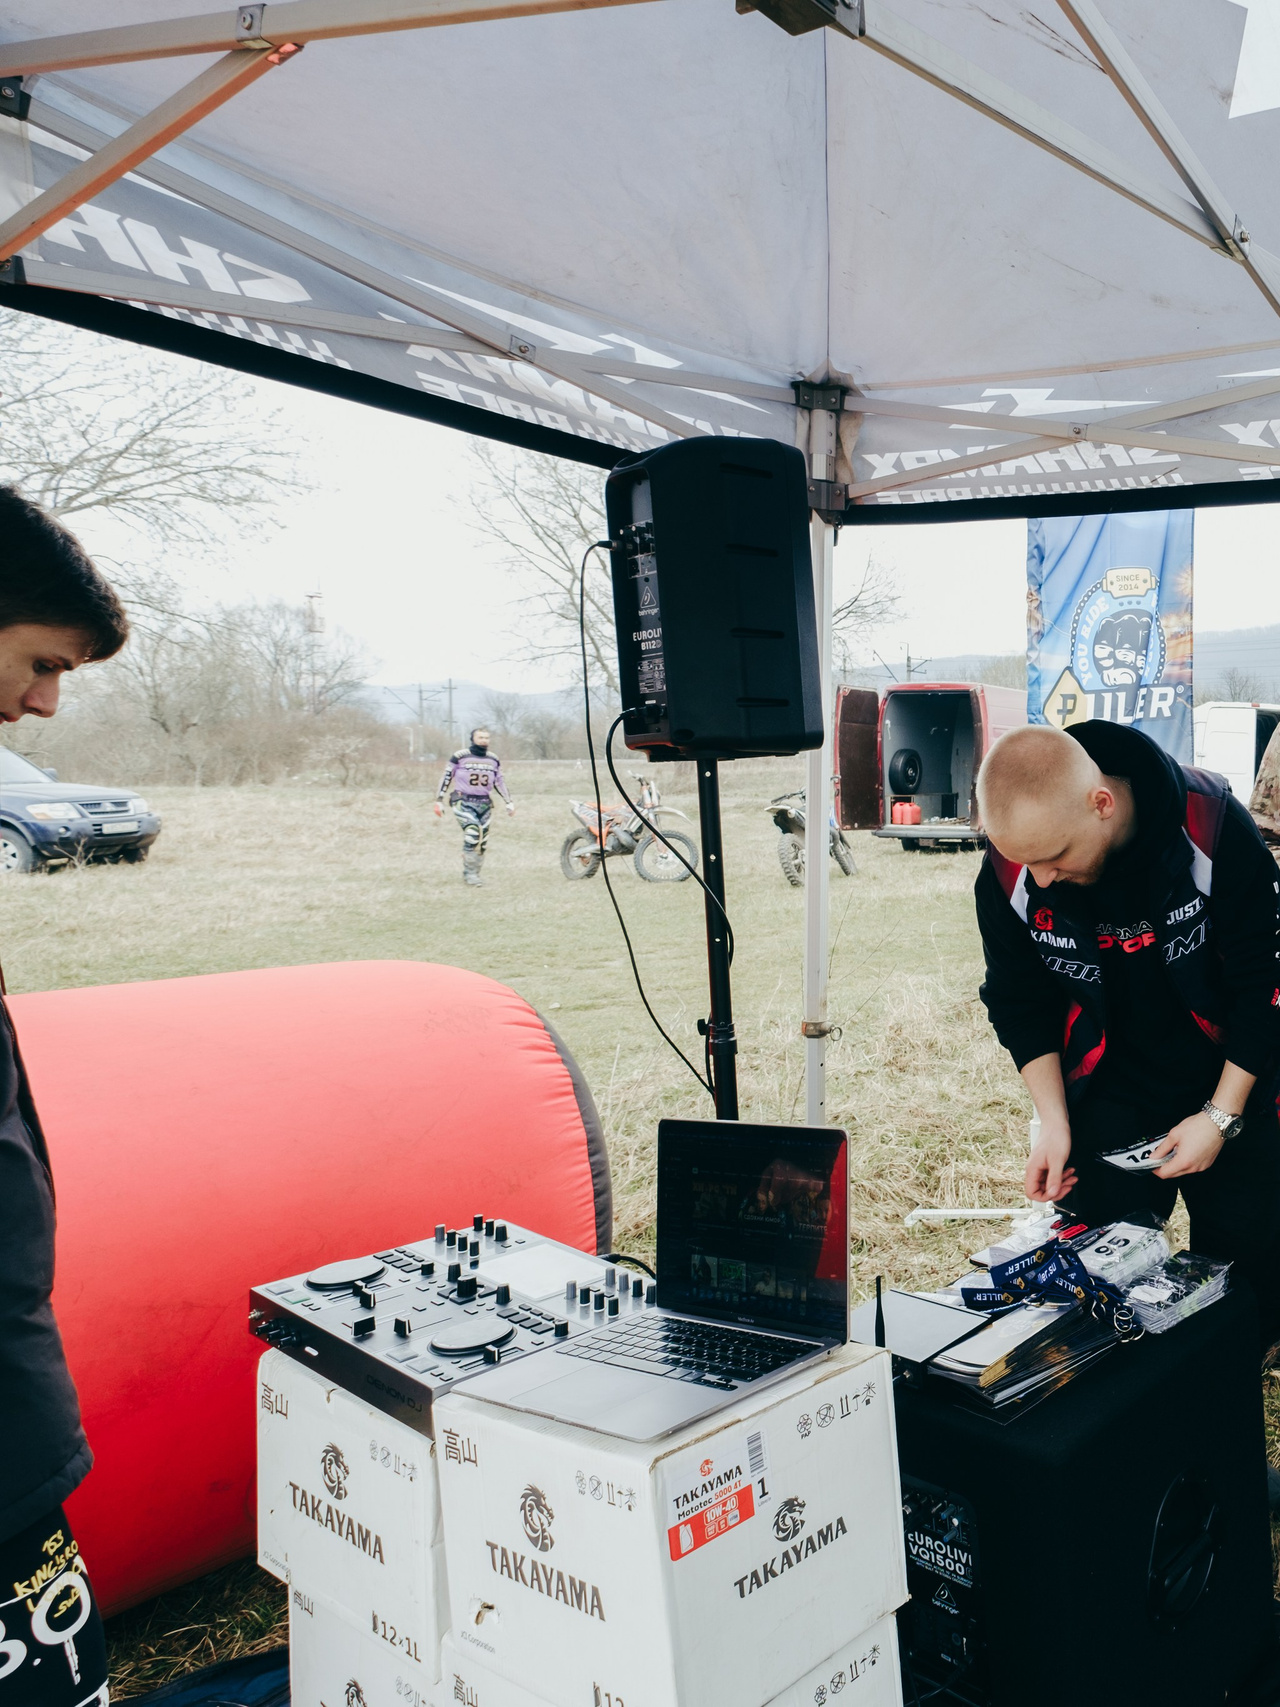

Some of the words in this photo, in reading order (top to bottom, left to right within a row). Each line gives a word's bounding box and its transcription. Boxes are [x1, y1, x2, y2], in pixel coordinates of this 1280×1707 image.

[1115, 574, 1140, 583] SINCE
[1118, 583, 1140, 592] 2014
[1080, 596, 1110, 638] RIDE
[1077, 645, 1093, 686] YOU
[469, 773, 490, 787] 23
[1030, 929, 1078, 950] KAYAMA
[1126, 1146, 1162, 1164] 14
[261, 1381, 289, 1420] 高山
[366, 1374, 406, 1403] DENON
[407, 1397, 423, 1413] DJ
[443, 1428, 479, 1467] 高山
[800, 1430, 812, 1440] PAP
[673, 1465, 743, 1510] TAKAYAMA
[677, 1497, 713, 1521] Mototec
[714, 1484, 733, 1501] 5000
[733, 1479, 742, 1492] 4T
[757, 1476, 769, 1500] 1
[288, 1480, 386, 1565] TAKAYAMA
[705, 1497, 737, 1523] 10W-40
[733, 1516, 848, 1599] TAKAYAMA
[485, 1539, 606, 1622] TAKAYAMA
